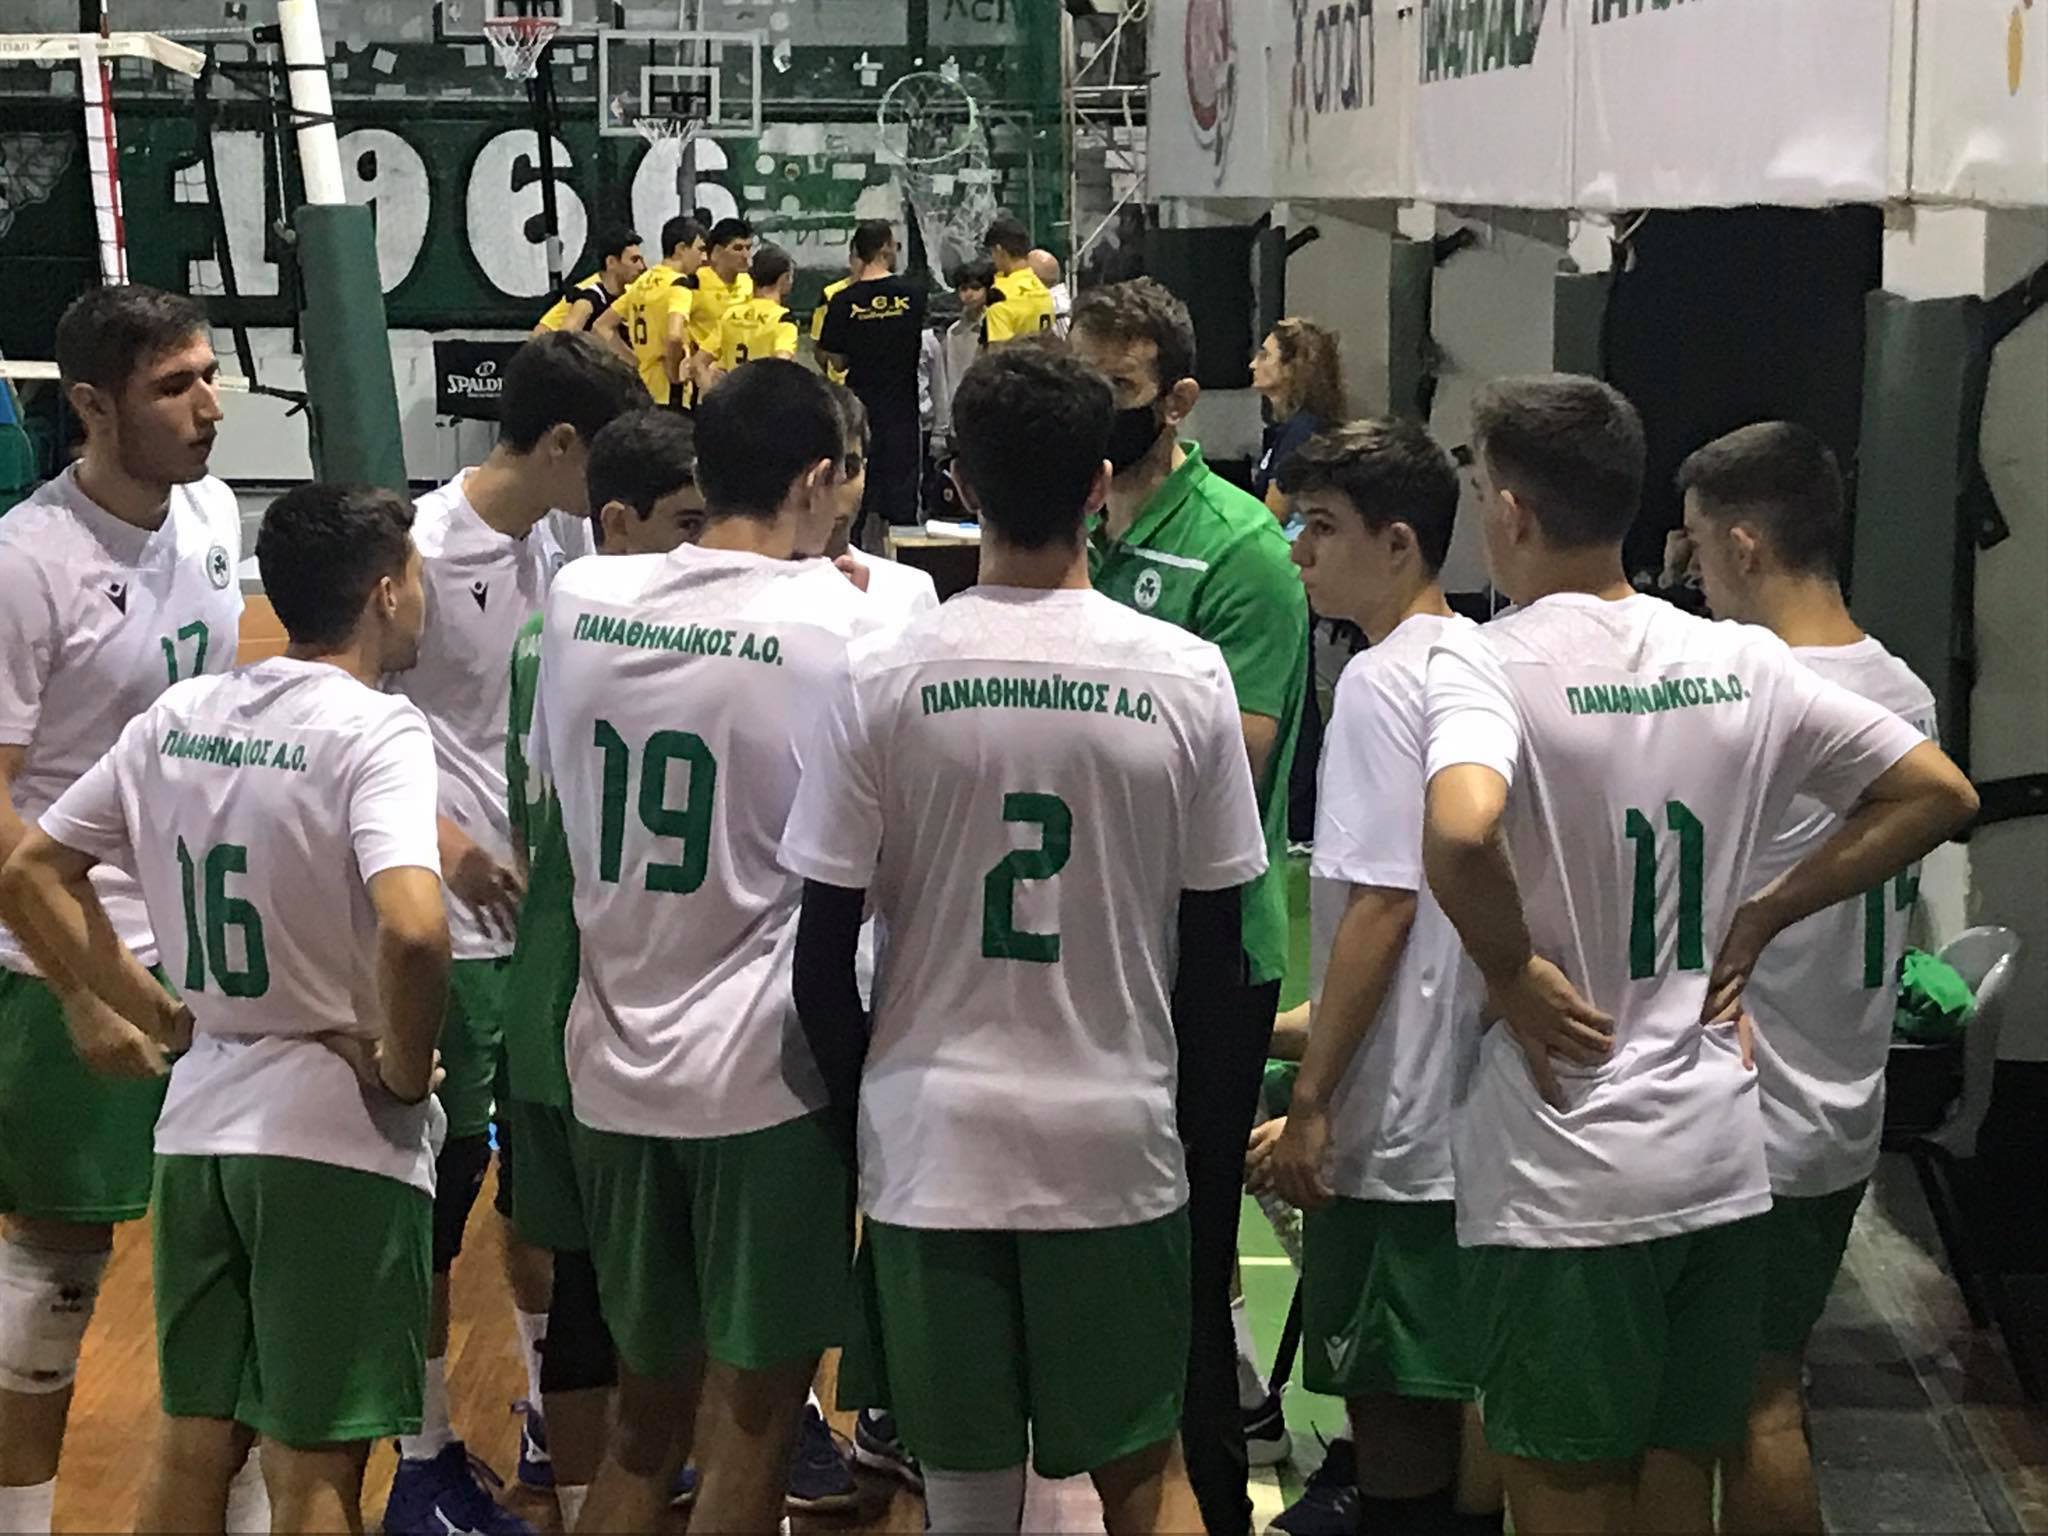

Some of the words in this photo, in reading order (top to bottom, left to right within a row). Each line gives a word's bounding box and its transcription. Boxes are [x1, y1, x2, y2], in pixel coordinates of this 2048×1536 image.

[174, 128, 740, 298] 1966
[160, 619, 209, 685] 17
[593, 718, 718, 895] 19
[981, 792, 1073, 964] 2
[1625, 799, 1705, 981] 11
[176, 834, 271, 999] 16
